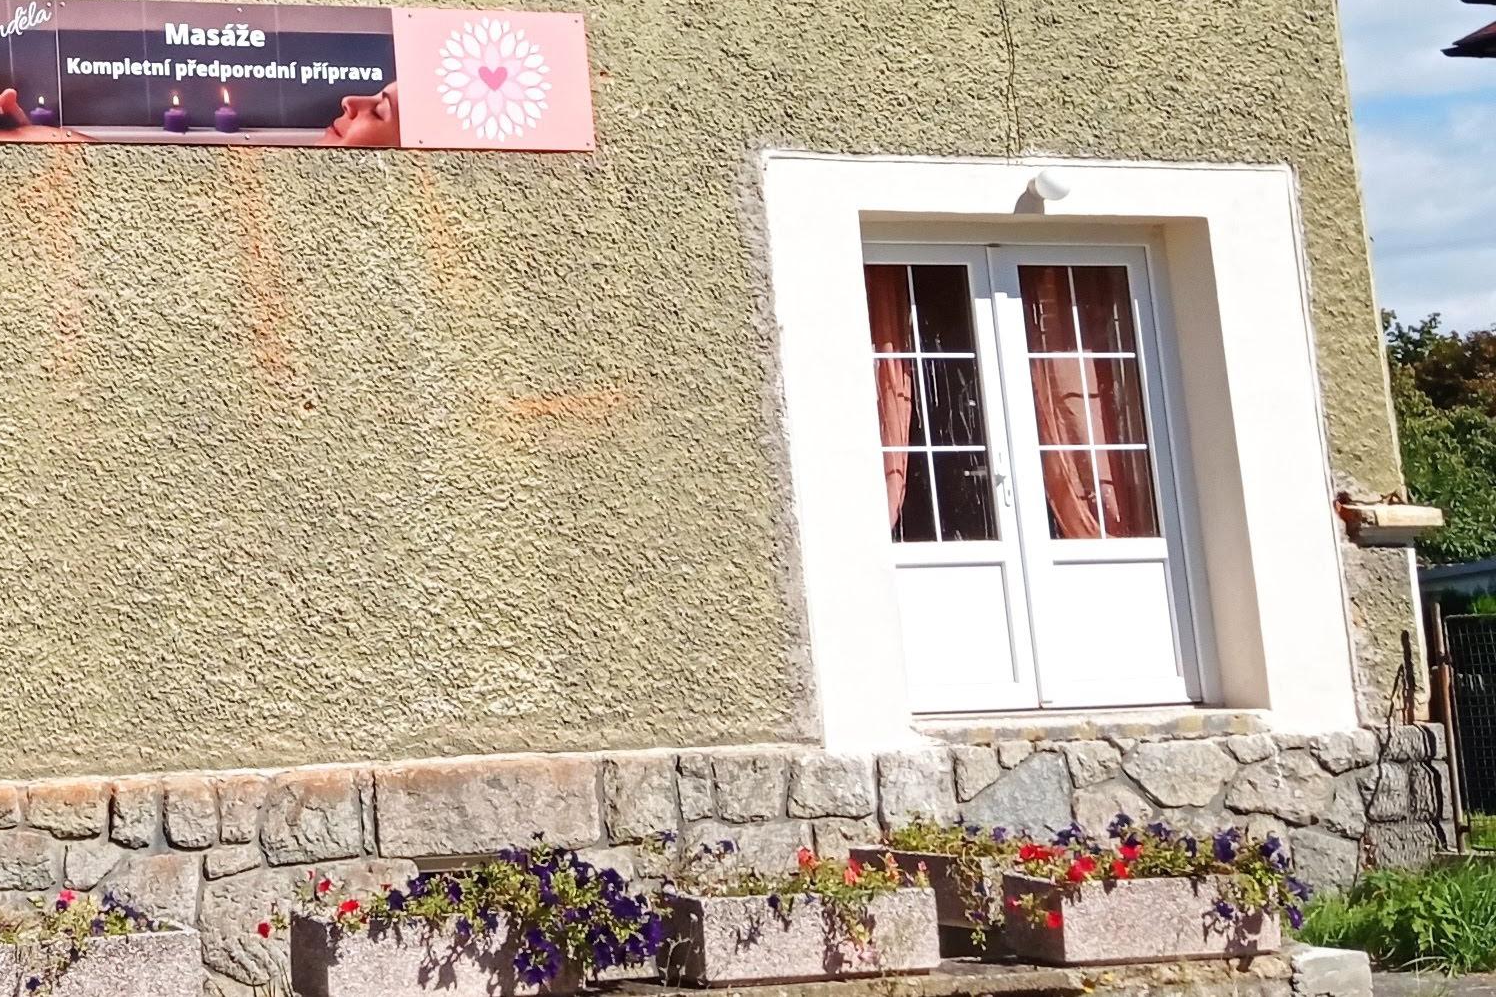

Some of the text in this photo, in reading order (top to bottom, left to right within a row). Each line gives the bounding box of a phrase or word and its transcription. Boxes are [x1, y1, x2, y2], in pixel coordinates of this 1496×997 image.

[165, 23, 266, 47] Masáže
[67, 57, 383, 84] Kompletní předporodní příprava
